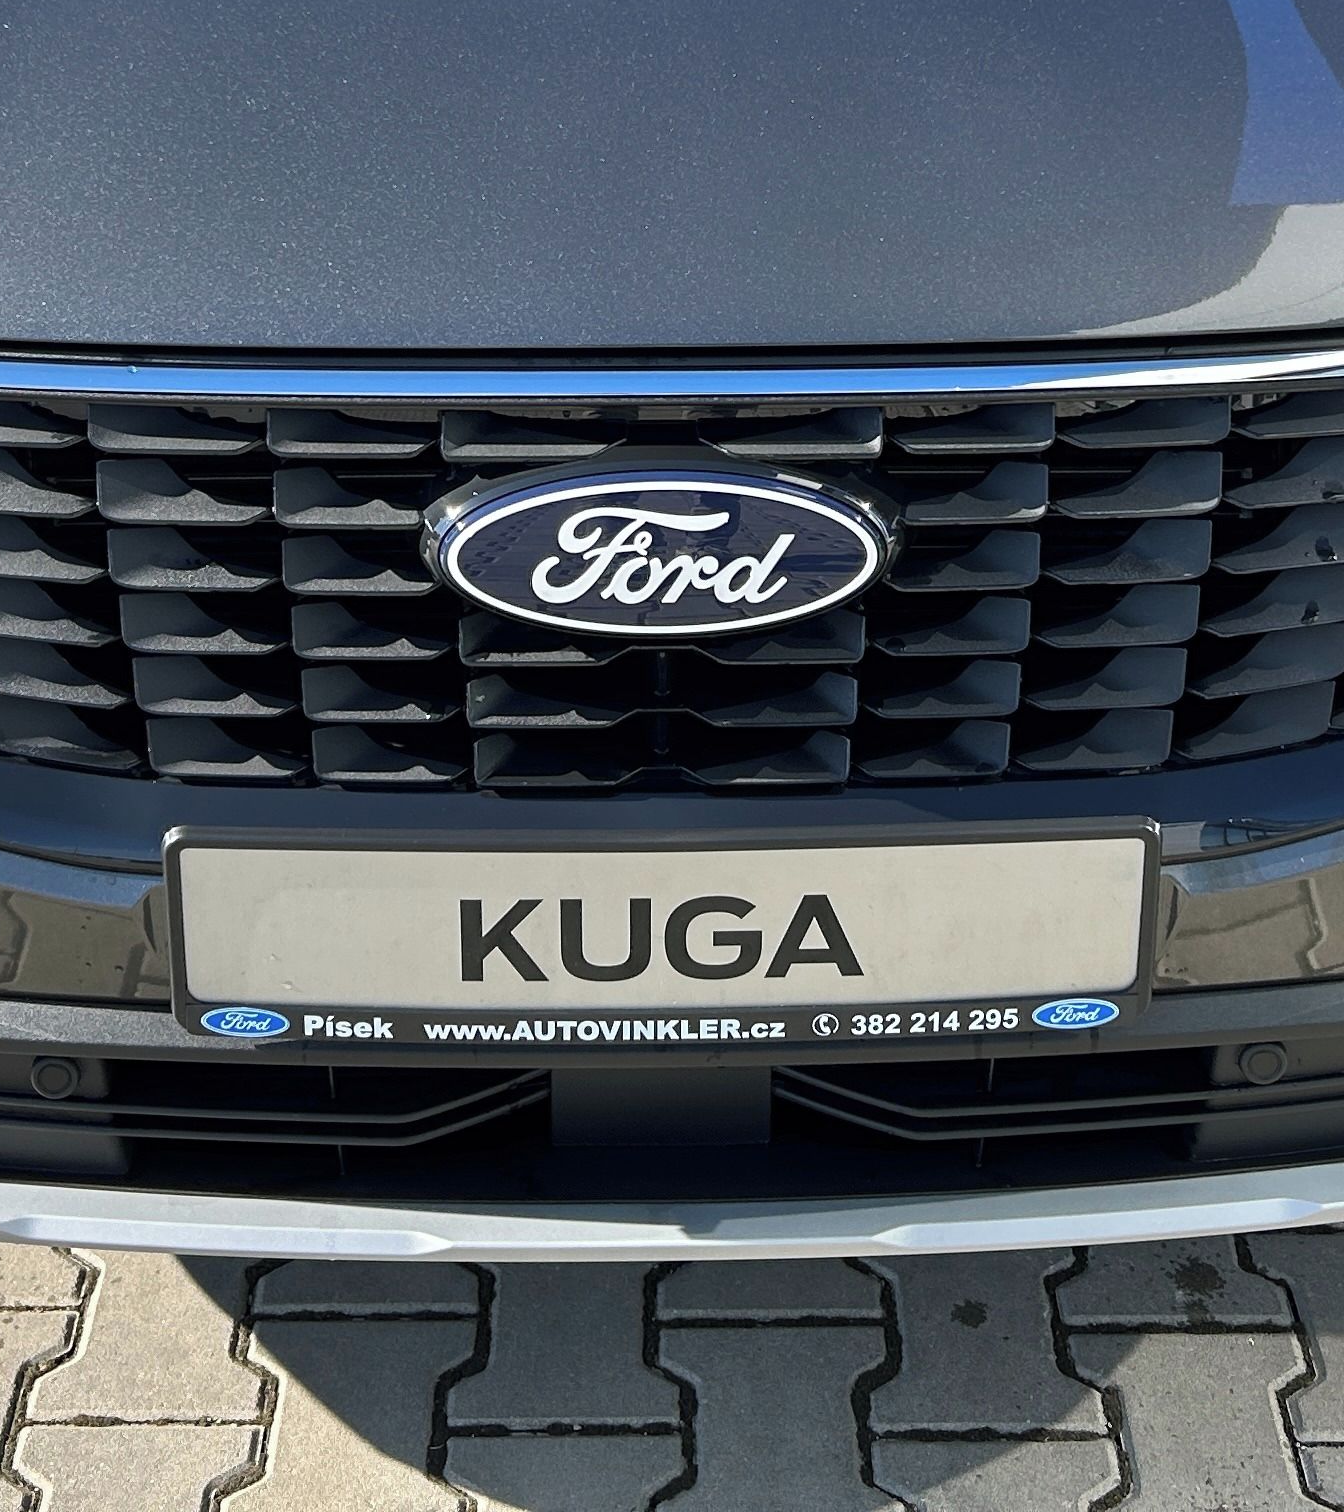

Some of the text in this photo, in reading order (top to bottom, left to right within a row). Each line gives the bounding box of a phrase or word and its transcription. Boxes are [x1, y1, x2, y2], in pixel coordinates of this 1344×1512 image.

[531, 506, 795, 605] Ford
[459, 894, 865, 982] KUGA
[220, 1004, 1101, 1041] Ford Písek www.AUTOVINKLER.cz 382 214 295 Ford
